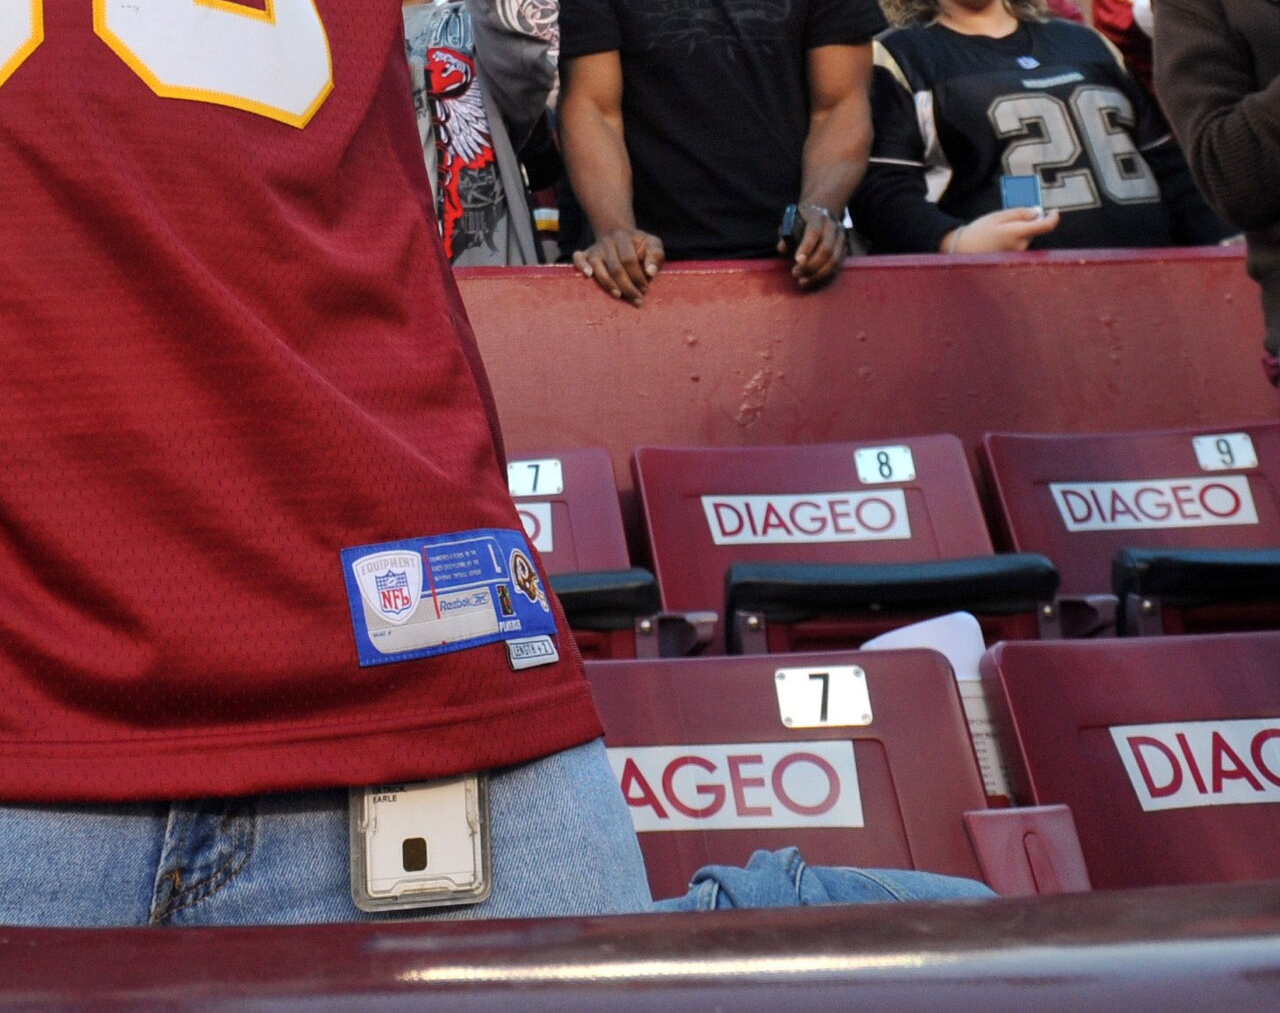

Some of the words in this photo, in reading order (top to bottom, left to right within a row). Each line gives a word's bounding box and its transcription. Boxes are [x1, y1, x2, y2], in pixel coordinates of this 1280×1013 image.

[987, 83, 1163, 214] 26
[876, 450, 893, 479] 8
[1215, 438, 1235, 467] 9
[526, 463, 540, 493] 7
[712, 497, 897, 537] DIAGEO
[1060, 483, 1242, 525] DIAGEO
[361, 556, 416, 576] EQUIPMENT
[380, 587, 410, 610] NFL
[807, 672, 830, 723] 7
[372, 794, 398, 804] EARLE
[621, 751, 841, 820] AGEO
